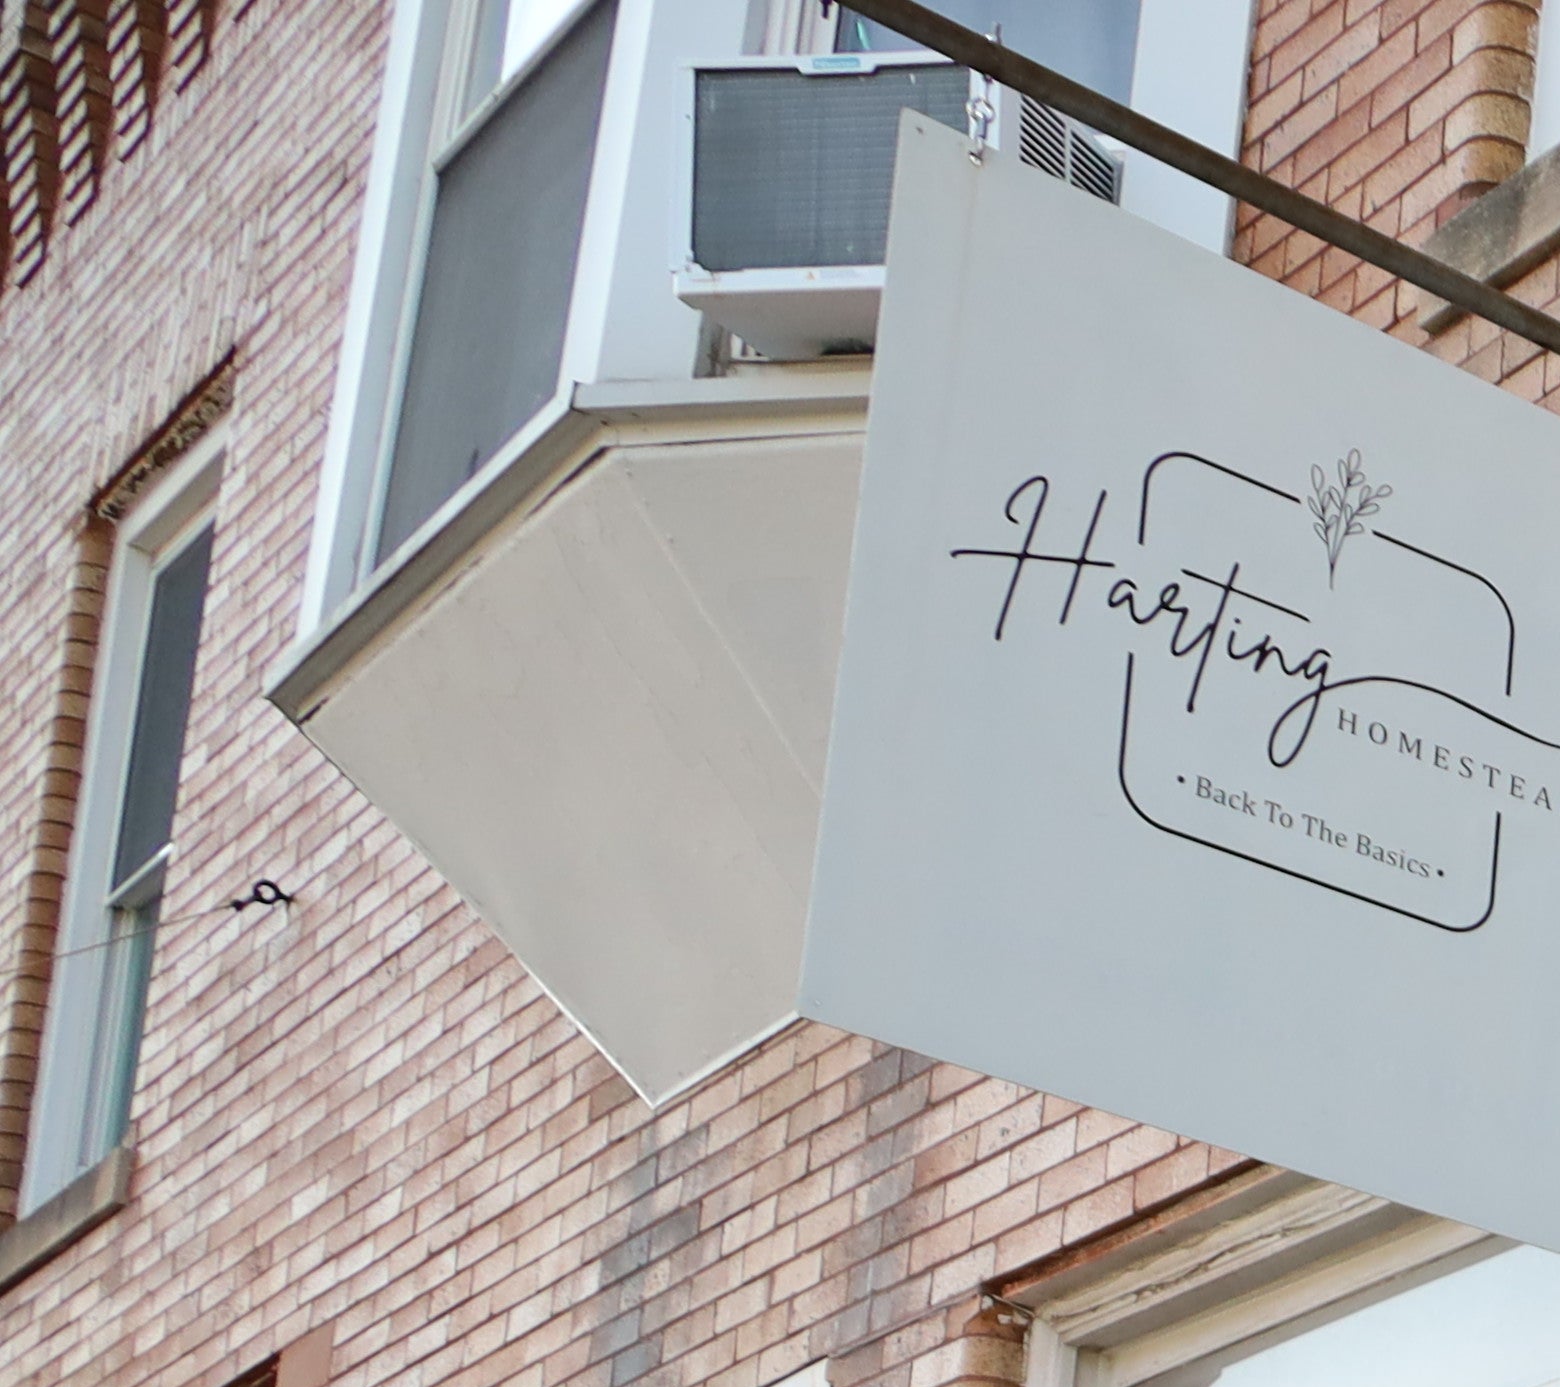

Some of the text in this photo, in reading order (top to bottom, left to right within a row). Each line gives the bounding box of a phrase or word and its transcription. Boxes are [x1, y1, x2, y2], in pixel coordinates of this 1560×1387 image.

[1194, 773, 1431, 879] Back To The Basics
